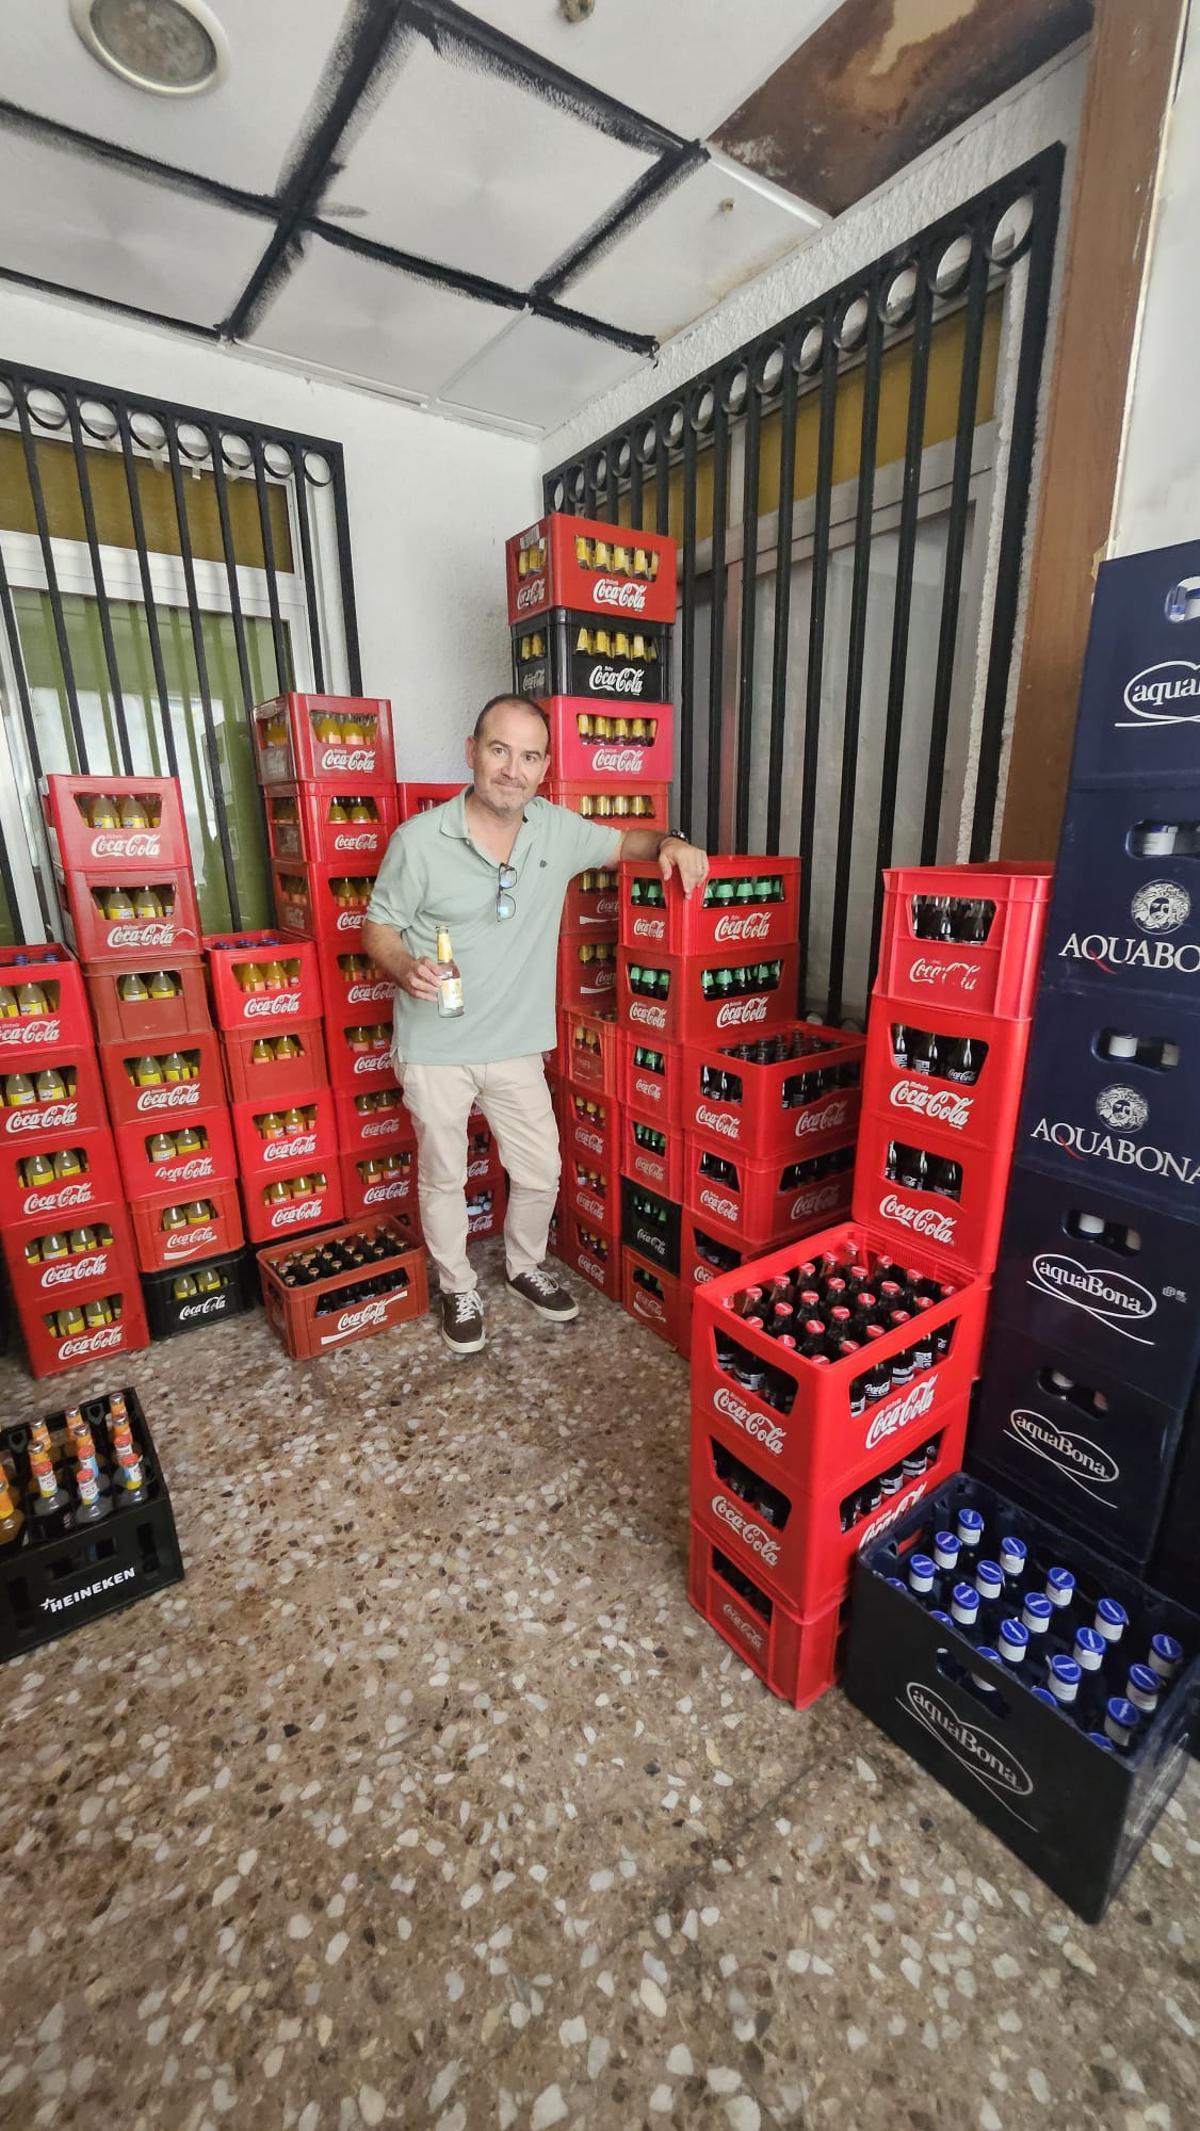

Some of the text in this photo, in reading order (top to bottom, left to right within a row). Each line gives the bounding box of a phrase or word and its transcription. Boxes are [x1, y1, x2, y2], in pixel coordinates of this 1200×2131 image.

[593, 578, 647, 609] Coca-Cola
[589, 665, 645, 693] Coca-Cola
[1132, 678, 1200, 706] aqua
[321, 749, 375, 771] Coca-Cola
[592, 748, 644, 772] Coca-Cola
[91, 834, 161, 857] Coca-Cola
[335, 833, 378, 850] Coca-Cola
[107, 923, 175, 948] Coca-Cola
[633, 918, 665, 939] Coca-Cola
[714, 911, 772, 942] Coca-Cola
[244, 992, 302, 1018] Coca-Cola
[629, 1001, 667, 1029] Coca-Cola
[716, 996, 769, 1028] Coca-Cola
[0, 1020, 60, 1044] ca-Cola
[137, 1083, 200, 1111] Coca-Cola
[890, 1080, 974, 1126] Coca-Cola
[6, 1102, 78, 1133] Coca-Cola
[695, 1104, 740, 1138] Coca-Cola
[795, 1101, 848, 1137] Coca-Cola
[263, 1134, 317, 1162] Coca-Cola
[23, 1183, 92, 1215] Coca-Cola
[363, 1180, 410, 1204] Coca-Cola
[700, 1189, 739, 1221] Coca-Cola
[272, 1200, 323, 1227] Coca-Cola
[879, 1193, 957, 1244] Coca-Cola
[166, 1226, 213, 1248] Coca-Cola
[41, 1254, 108, 1288] Coca-Cola
[179, 1295, 226, 1320] Coca-Cola
[337, 1299, 387, 1331] Coca-Cola
[58, 1325, 124, 1360] Coca-Cola
[713, 1388, 787, 1455] Coca-Cola
[865, 1372, 939, 1449] Coca-Cola
[711, 1495, 781, 1566] Coca-Cola
[50, 1566, 136, 1613] HEINEKEN
